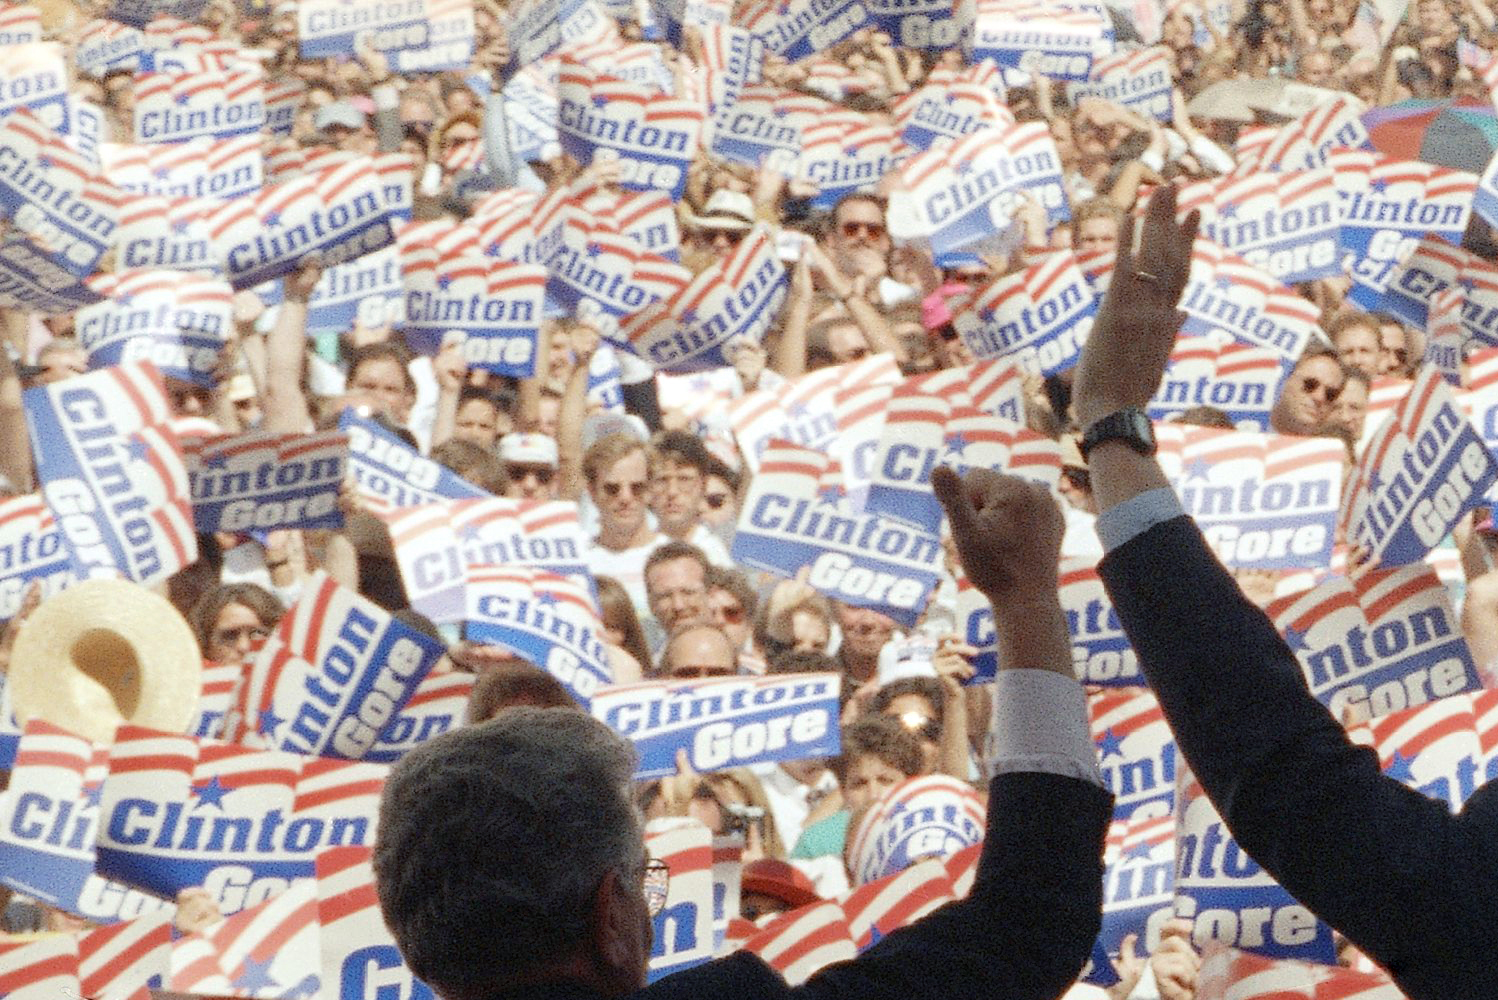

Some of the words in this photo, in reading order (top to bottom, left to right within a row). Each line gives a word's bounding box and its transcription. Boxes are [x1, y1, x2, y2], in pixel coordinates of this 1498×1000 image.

[142, 101, 262, 138] Clinton
[560, 103, 688, 150] Clinton
[732, 115, 796, 141] Clin
[914, 101, 990, 134] Clint
[809, 156, 904, 182] Clint
[926, 151, 1053, 224] Clinton
[228, 193, 382, 272] Clinton
[1206, 201, 1332, 249] linton
[1350, 193, 1463, 226] linton
[125, 237, 208, 267] Clin
[1371, 231, 1422, 260] Go
[330, 257, 397, 290] lint
[651, 258, 776, 362] Clinton
[1191, 283, 1298, 352] linton
[1165, 377, 1266, 405] nton
[753, 407, 837, 460] Clin
[59, 387, 163, 581] Clinton
[190, 454, 341, 497] linton
[1184, 473, 1331, 515] inton
[1411, 443, 1489, 538] Gore
[222, 497, 336, 528] Gore
[751, 494, 940, 564] Clinton
[811, 553, 924, 607] Gore
[477, 594, 608, 665] Clint
[1308, 607, 1447, 684] nton
[281, 607, 380, 755] inton
[335, 639, 424, 758] Gore
[606, 681, 827, 733] Clinton
[694, 708, 830, 770] Gore
[109, 798, 369, 852] Clinton
[78, 875, 177, 919] Go
[205, 865, 318, 915] Go
